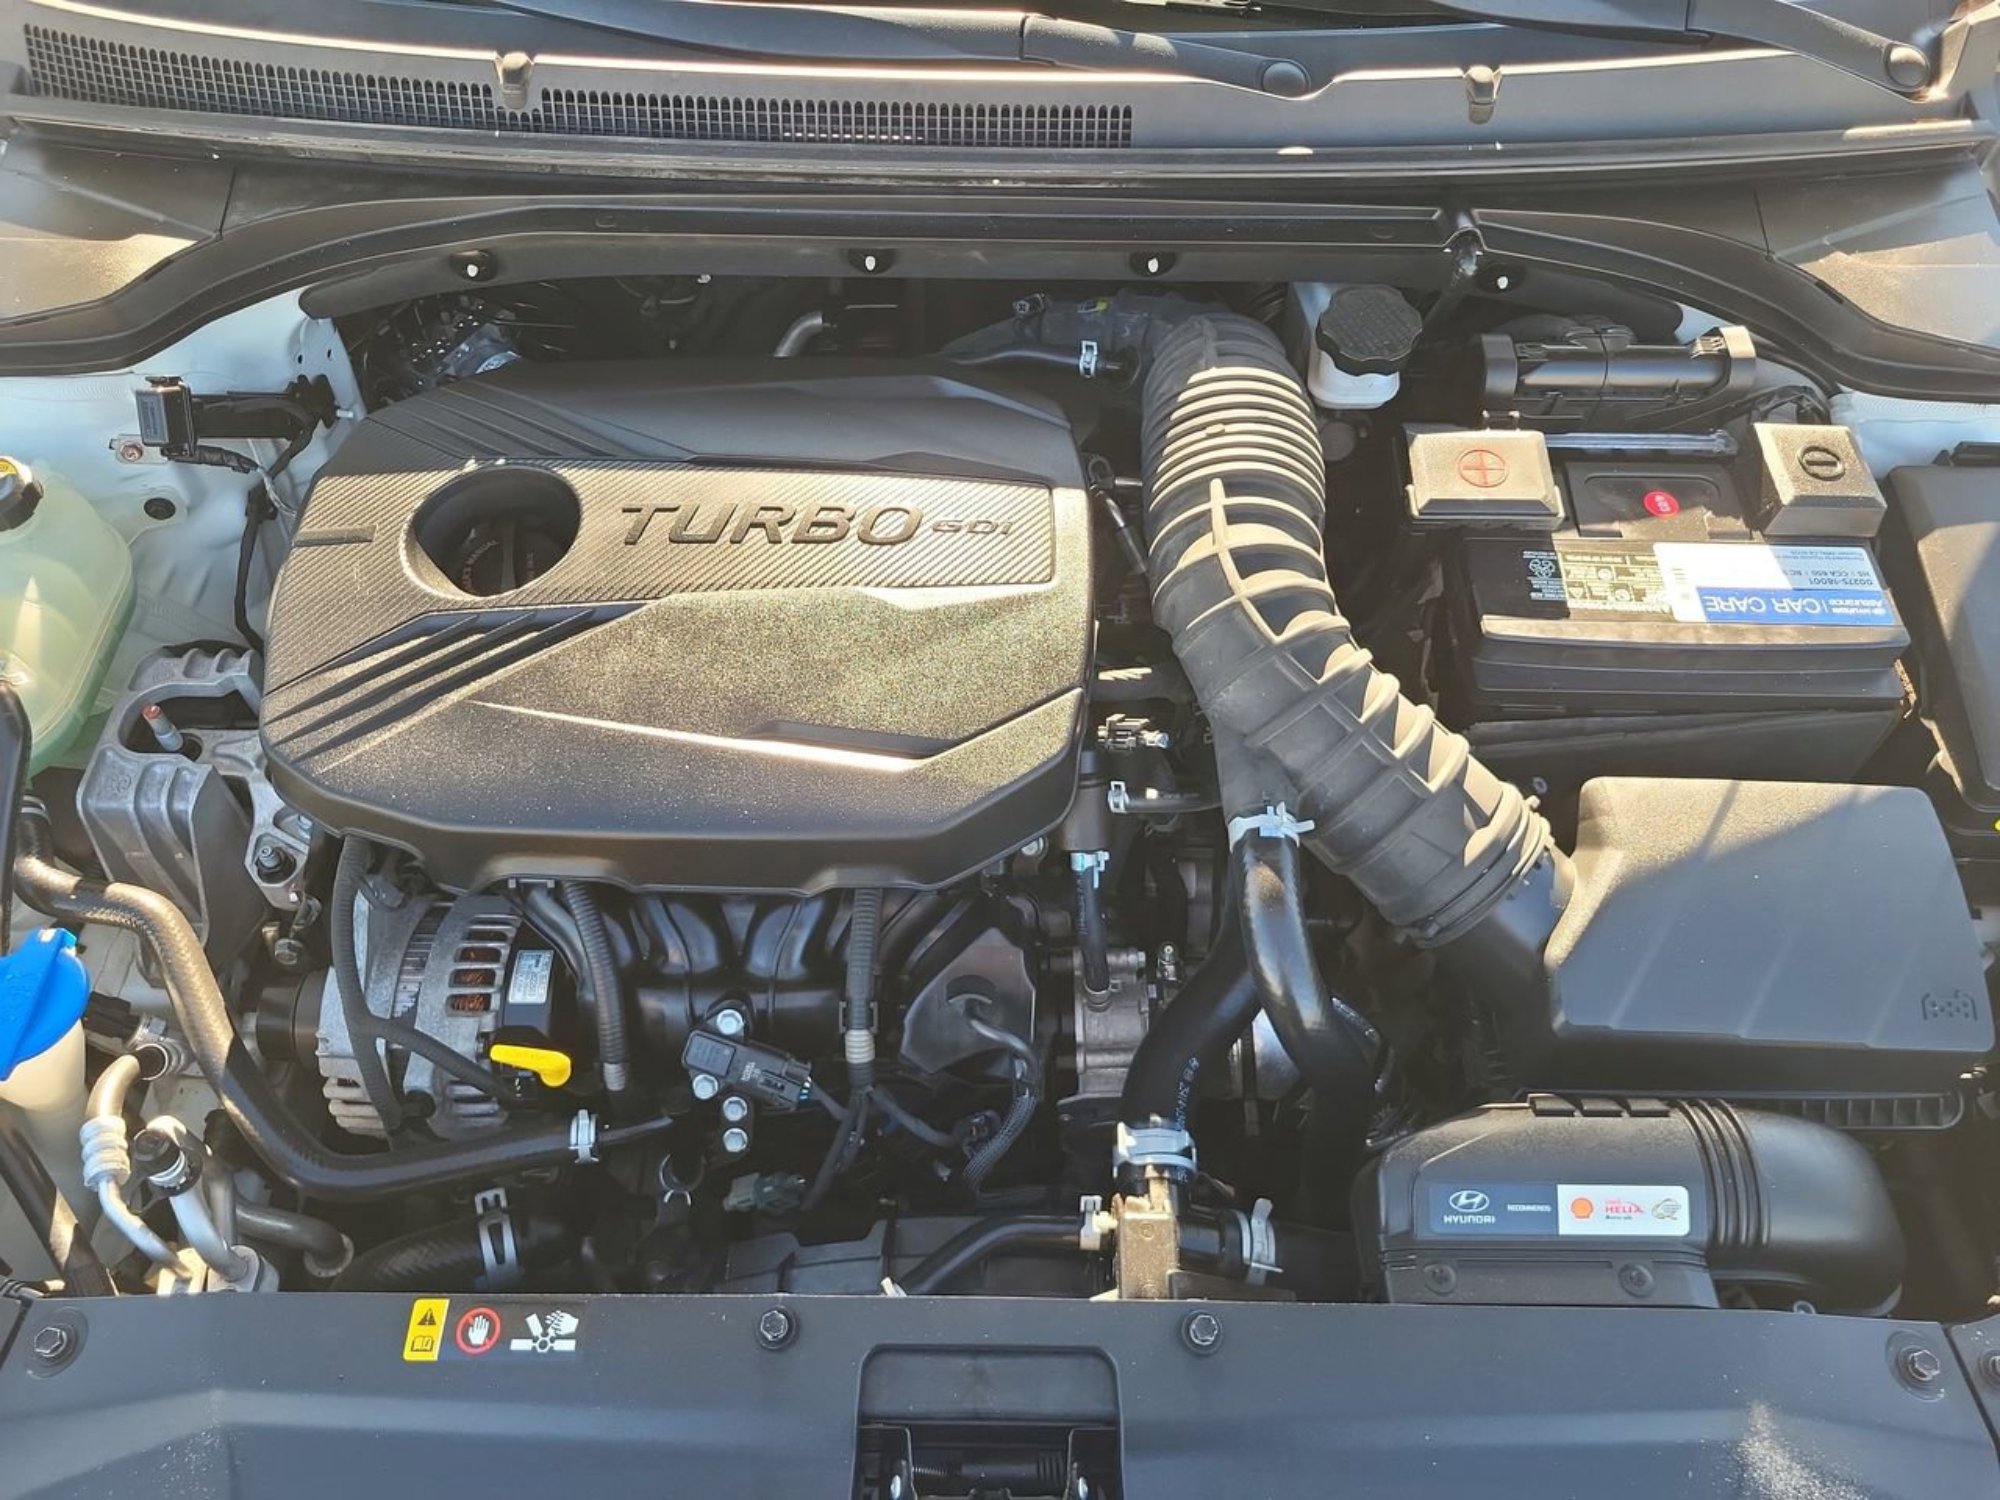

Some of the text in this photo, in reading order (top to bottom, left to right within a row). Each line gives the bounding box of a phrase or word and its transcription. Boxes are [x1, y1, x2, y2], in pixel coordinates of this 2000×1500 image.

[621, 501, 924, 546] TURBO
[1702, 594, 1821, 614] CAR CARE
[1507, 1203, 1552, 1212] RECOMMENDS
[1605, 1203, 1644, 1214] HELIX
[1443, 1214, 1496, 1225] HYUNDAI
